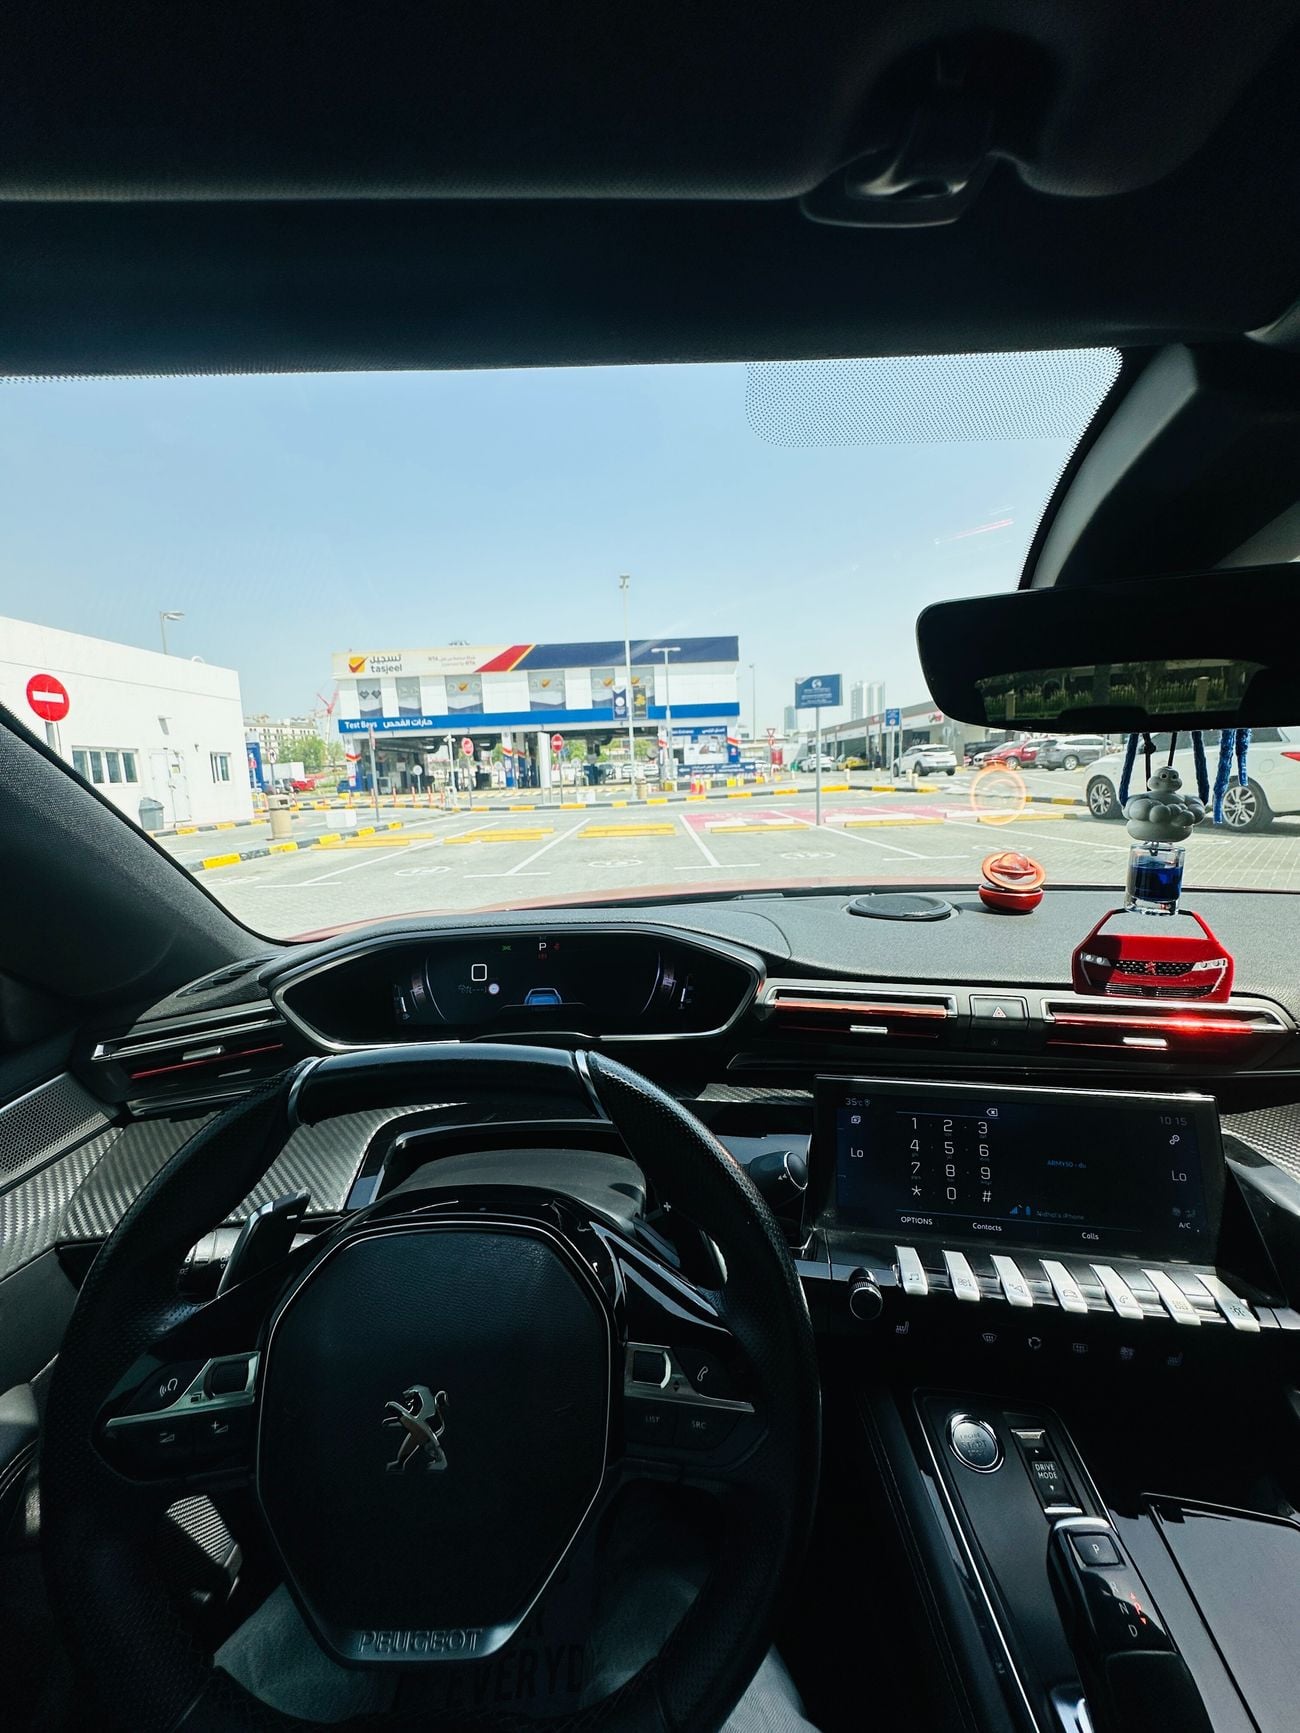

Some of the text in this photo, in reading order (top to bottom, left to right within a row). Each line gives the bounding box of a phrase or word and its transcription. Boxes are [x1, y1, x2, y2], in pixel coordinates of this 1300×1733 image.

[370, 653, 402, 664] تسجيل
[370, 664, 403, 675] tasjeel
[344, 721, 361, 729] Test
[382, 717, 433, 729] حارات الفحص
[538, 942, 547, 952] P
[911, 1117, 988, 1135] 1 2 3
[850, 1147, 864, 1158] Lo
[910, 1139, 989, 1157] 4 5 6
[911, 1161, 991, 1180] 7 8 9
[1171, 1170, 1187, 1182] Lo
[946, 1187, 992, 1203] 0 #
[900, 1216, 933, 1226] OPTIONS
[972, 1222, 1003, 1233] Contacts
[1081, 1231, 1100, 1241] Calls
[691, 1420, 706, 1429] SRC
[960, 1440, 987, 1449] START
[1034, 1463, 1055, 1471] DRIVE
[1092, 1543, 1100, 1554] P
[1118, 1602, 1129, 1615] N
[1128, 1623, 1138, 1638] D
[357, 1628, 484, 1655] PEUGEOT
